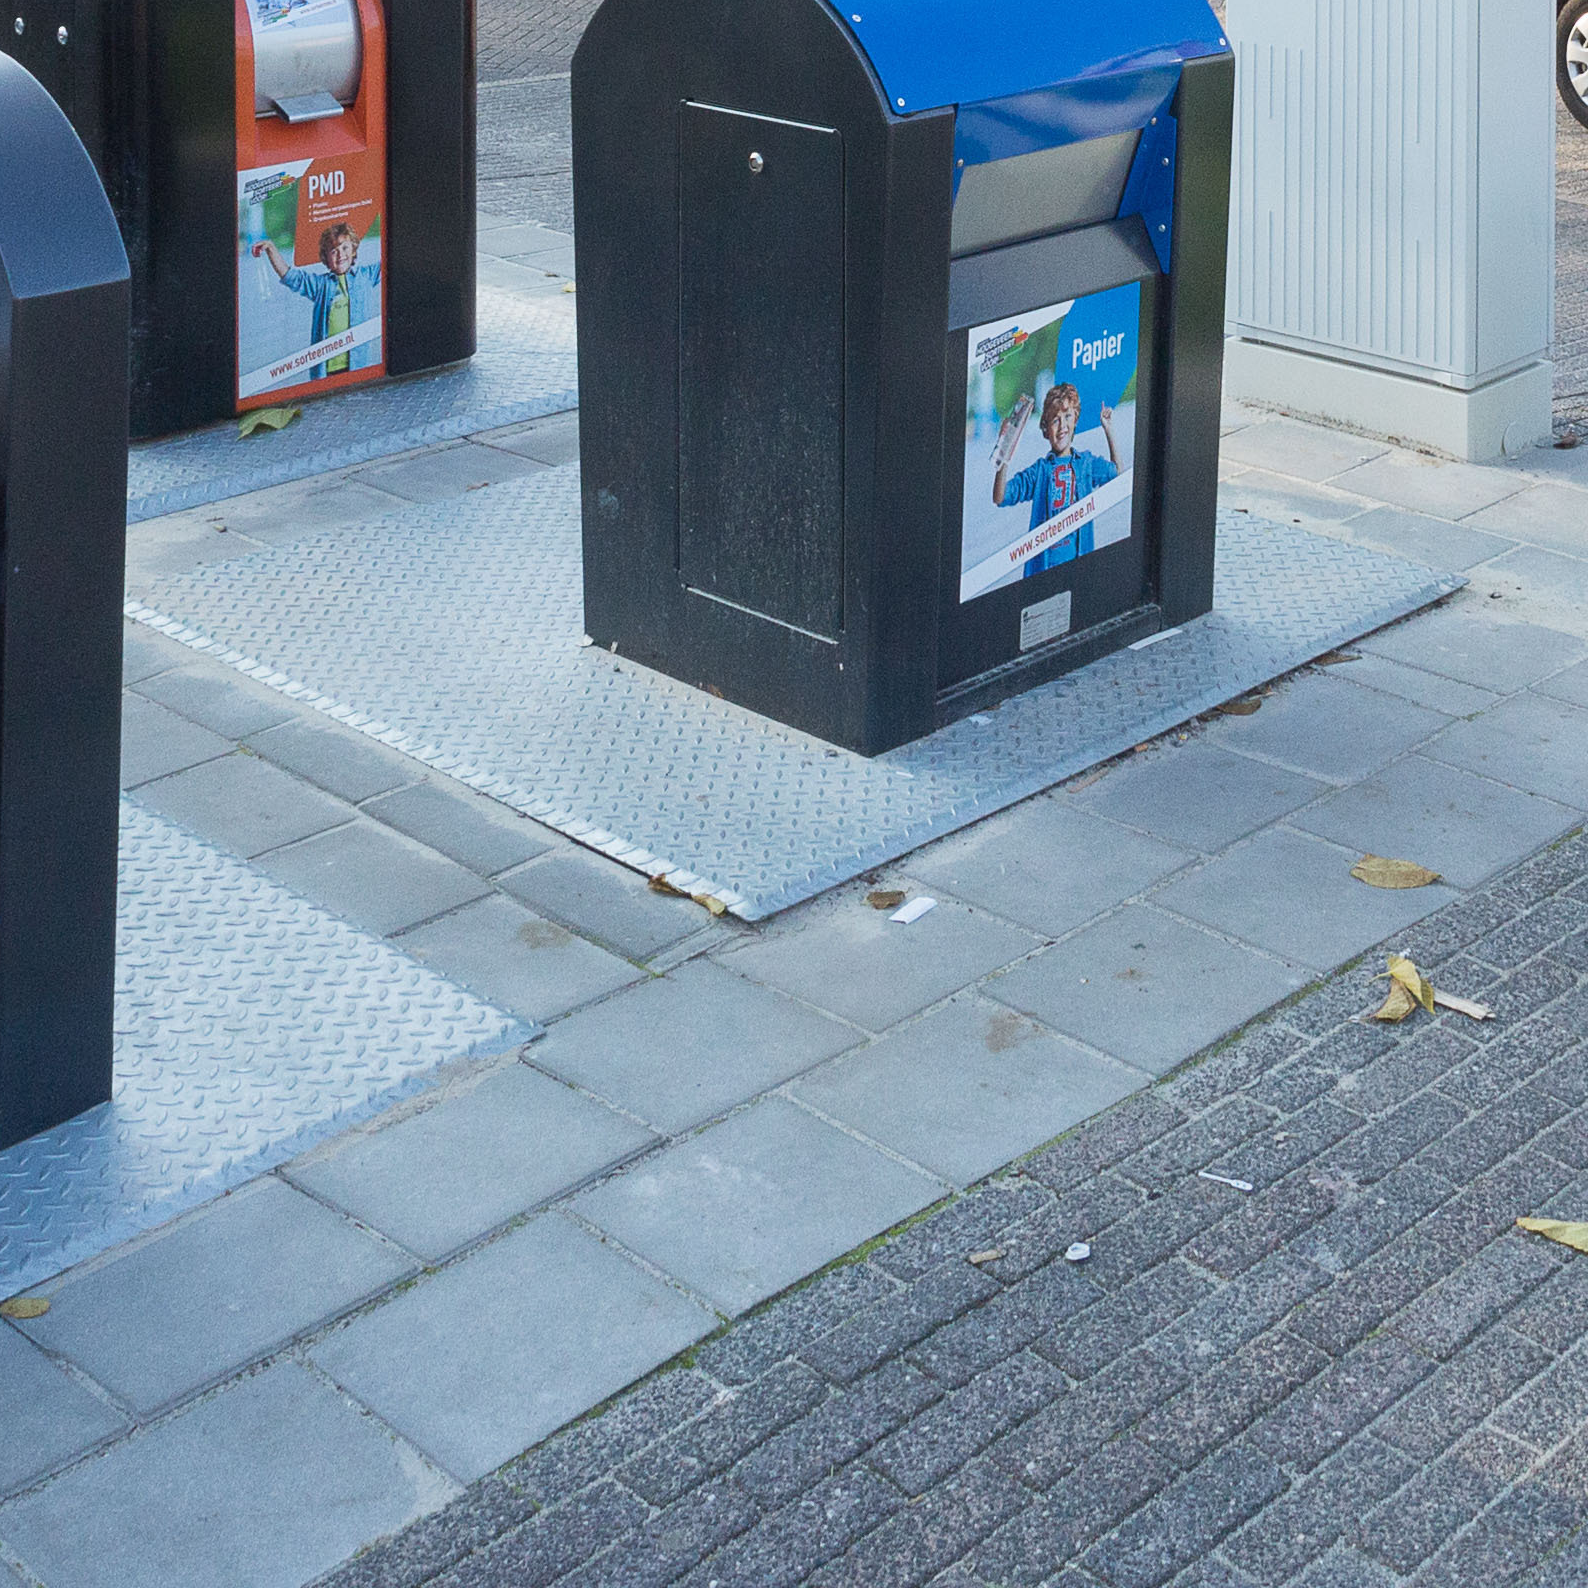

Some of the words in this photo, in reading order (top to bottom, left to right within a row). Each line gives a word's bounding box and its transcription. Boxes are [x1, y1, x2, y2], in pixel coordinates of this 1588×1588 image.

[307, 170, 346, 200] PMD
[269, 331, 355, 379] www.sorteermee.nl
[1072, 329, 1125, 371] Papier
[1009, 496, 1097, 562] www.sorteermee.nl
